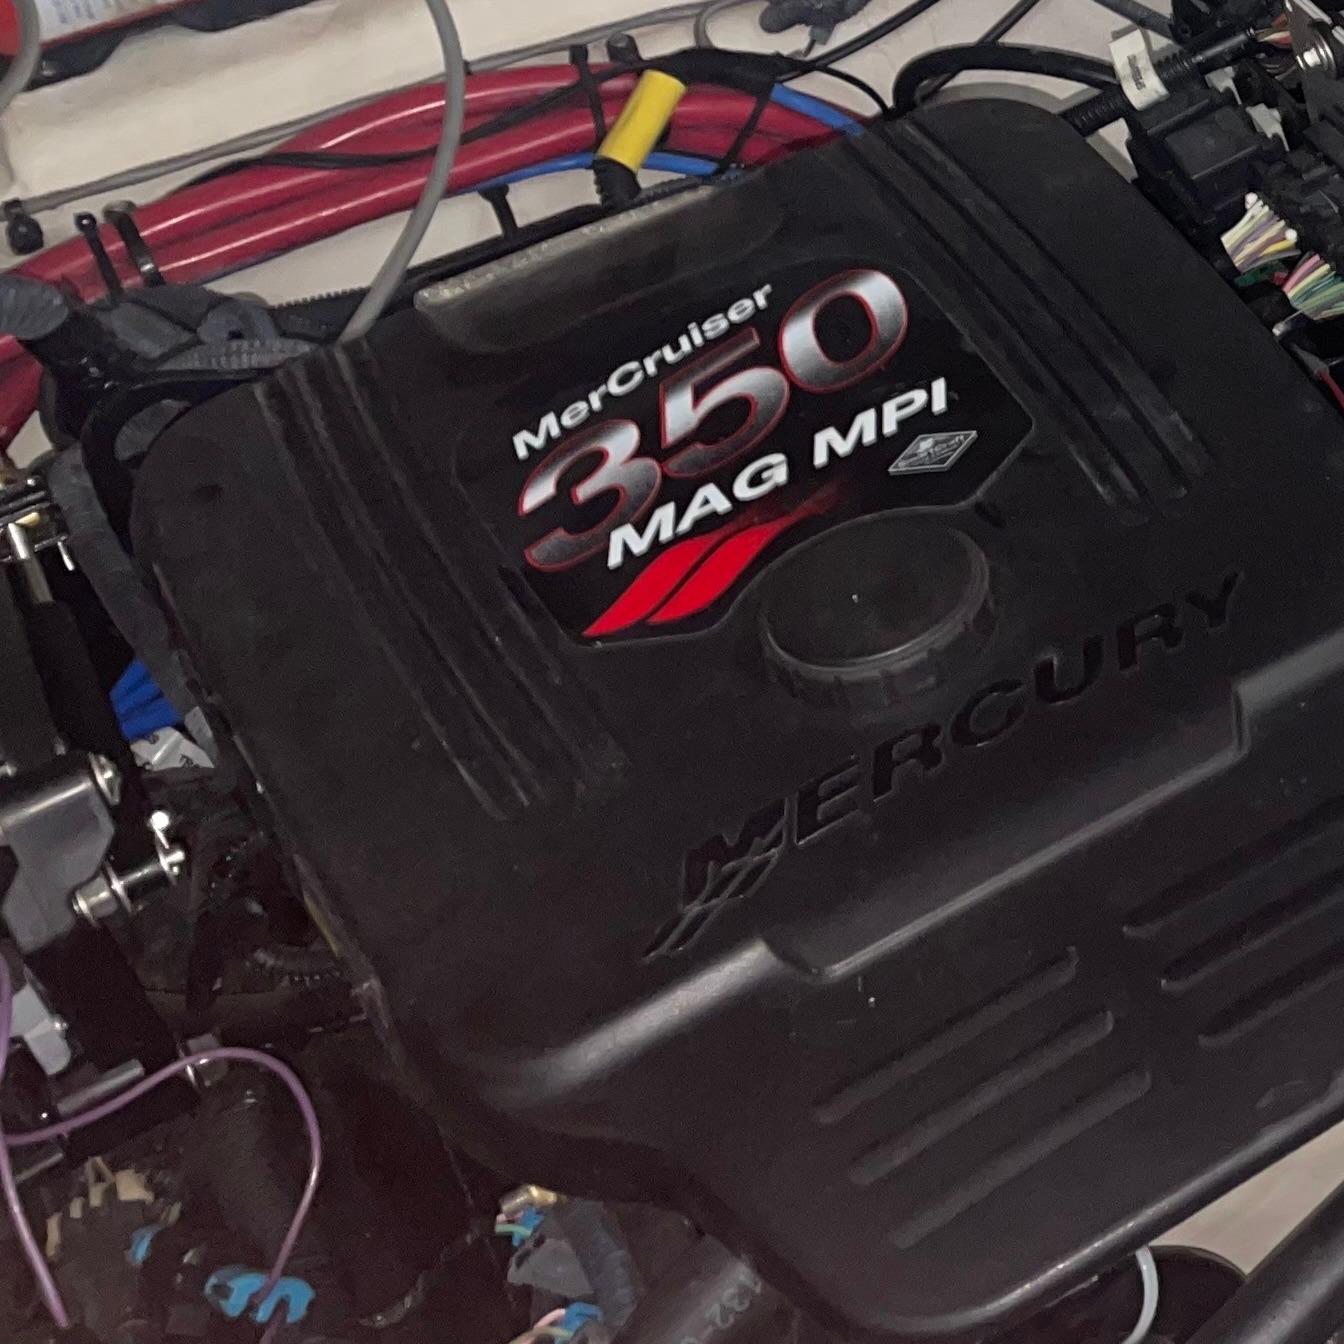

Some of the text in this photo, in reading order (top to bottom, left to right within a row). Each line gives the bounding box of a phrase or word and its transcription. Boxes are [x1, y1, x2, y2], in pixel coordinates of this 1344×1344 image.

[513, 283, 773, 461] MerCruiser
[517, 268, 908, 572] 350
[606, 376, 951, 570] MAG MPI
[683, 570, 1243, 906] MERCURY
